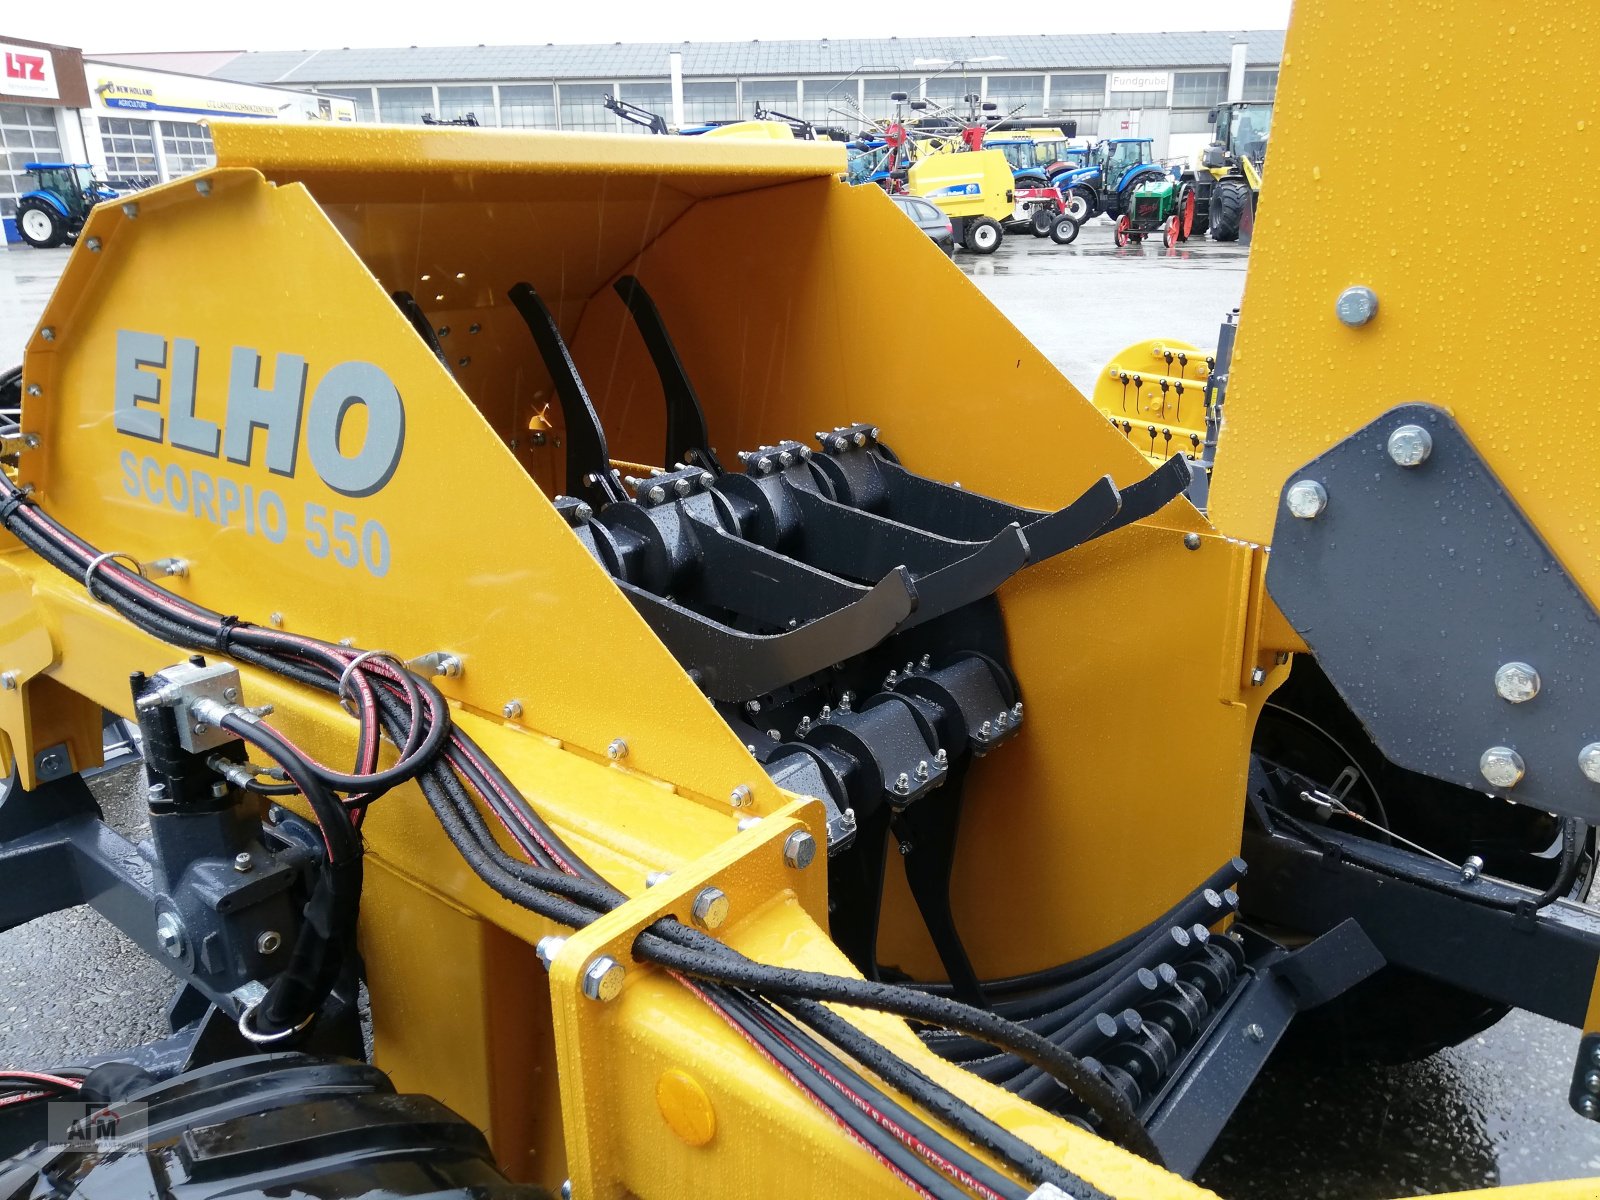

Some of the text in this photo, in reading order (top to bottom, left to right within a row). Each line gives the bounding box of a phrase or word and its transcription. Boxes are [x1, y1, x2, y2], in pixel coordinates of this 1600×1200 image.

[5, 52, 45, 81] LTZ
[116, 85, 153, 97] NEW HOLLAND
[1113, 76, 1166, 88] Fundgrube
[118, 98, 148, 109] AGRICULTURE
[114, 329, 406, 499] ELHO
[119, 450, 288, 545] SCORPIO
[304, 501, 392, 578] 550
